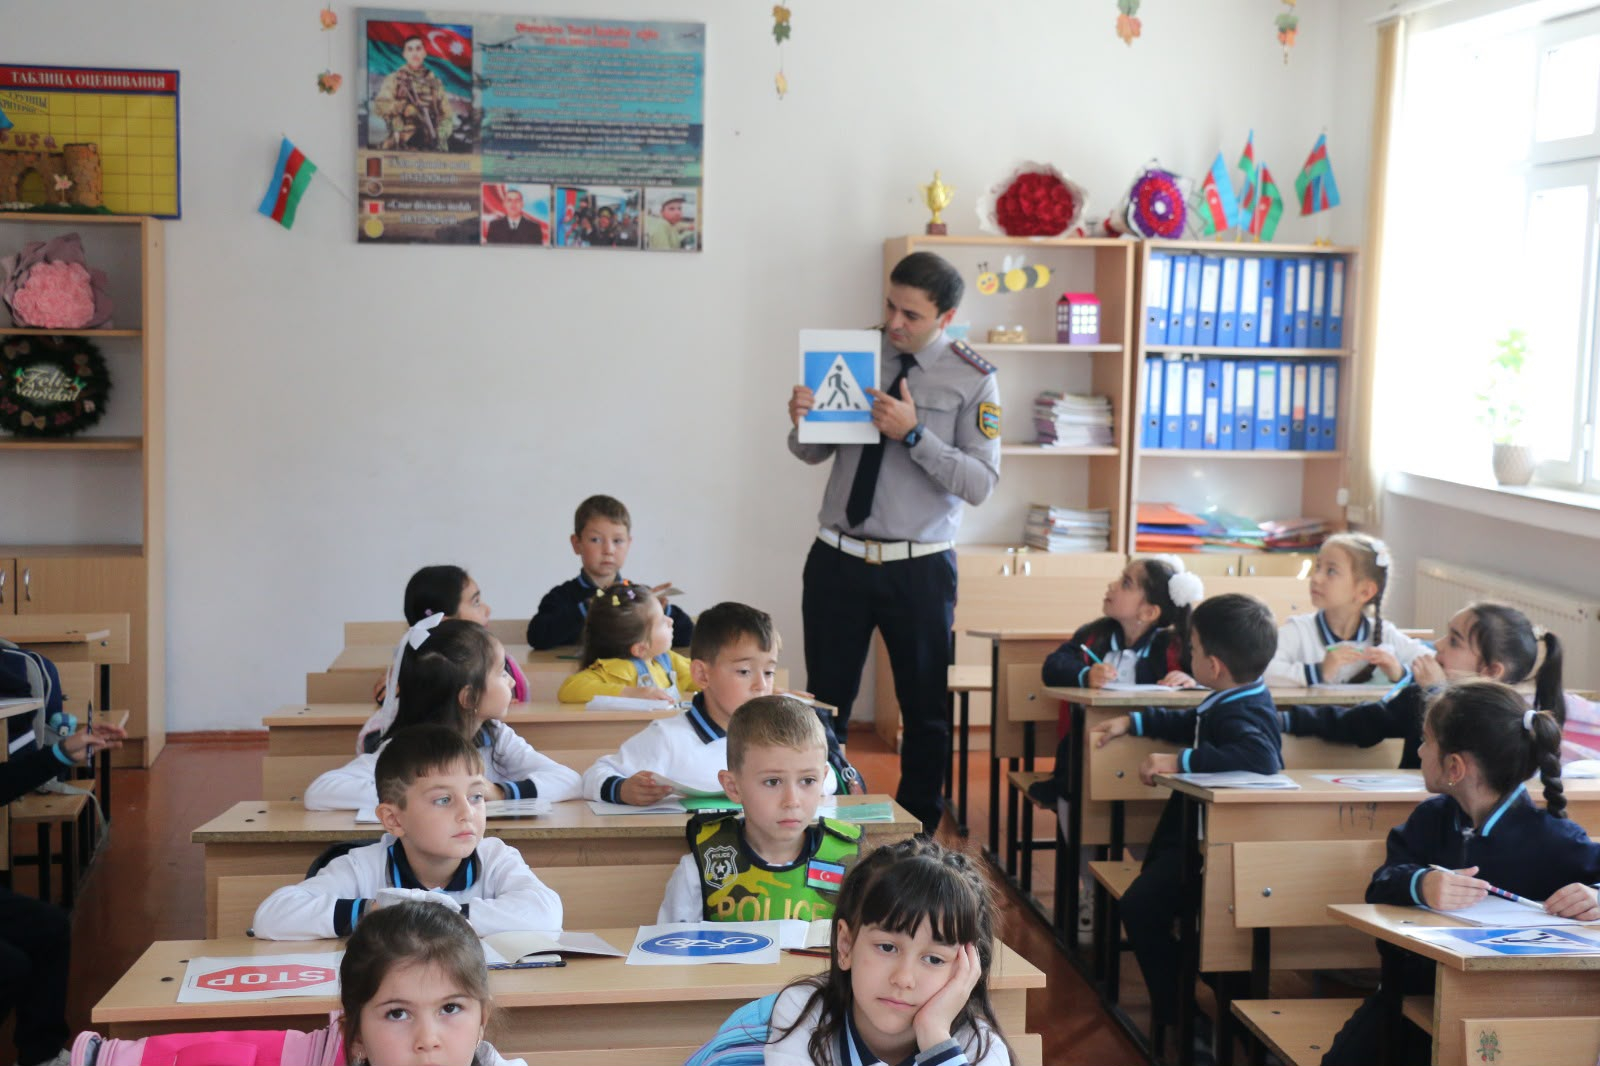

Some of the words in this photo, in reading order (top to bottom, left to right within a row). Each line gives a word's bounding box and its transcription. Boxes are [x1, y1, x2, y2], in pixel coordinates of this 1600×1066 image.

[10, 71, 73, 87] ТАБЛИЦА
[75, 73, 166, 89] ОЦЕНИВАНИЯ
[207, 970, 326, 986] STOP
